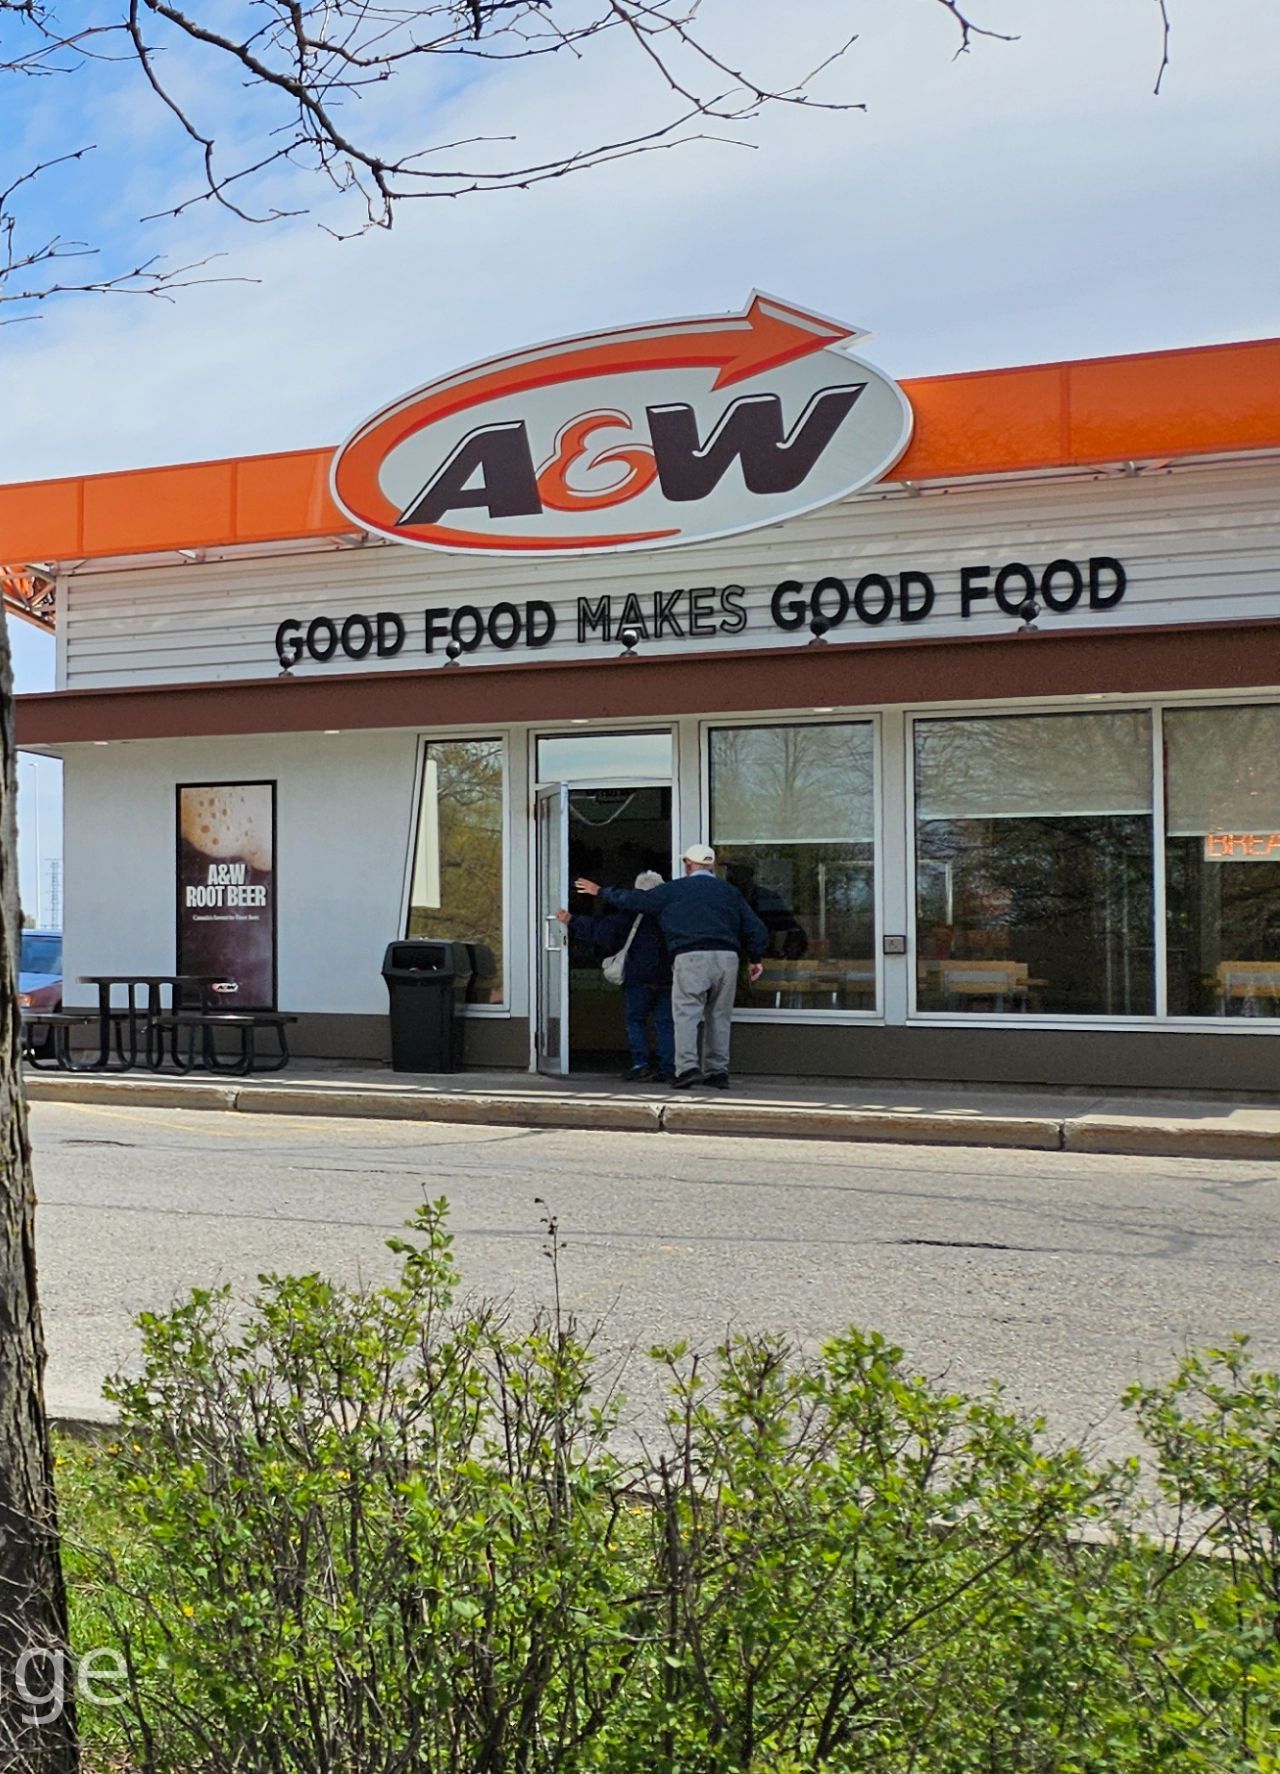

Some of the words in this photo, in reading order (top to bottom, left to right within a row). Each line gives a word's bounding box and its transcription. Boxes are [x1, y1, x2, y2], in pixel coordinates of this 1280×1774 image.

[395, 382, 869, 525] A&W
[275, 612, 406, 662] GOOD
[425, 600, 556, 654] FOOD
[577, 585, 748, 644] MAKES
[771, 570, 936, 630] GOOD
[961, 557, 1127, 618] FOOD
[186, 885, 225, 907] ROOT
[227, 885, 266, 907] BEER
[207, 864, 246, 885] A&W
